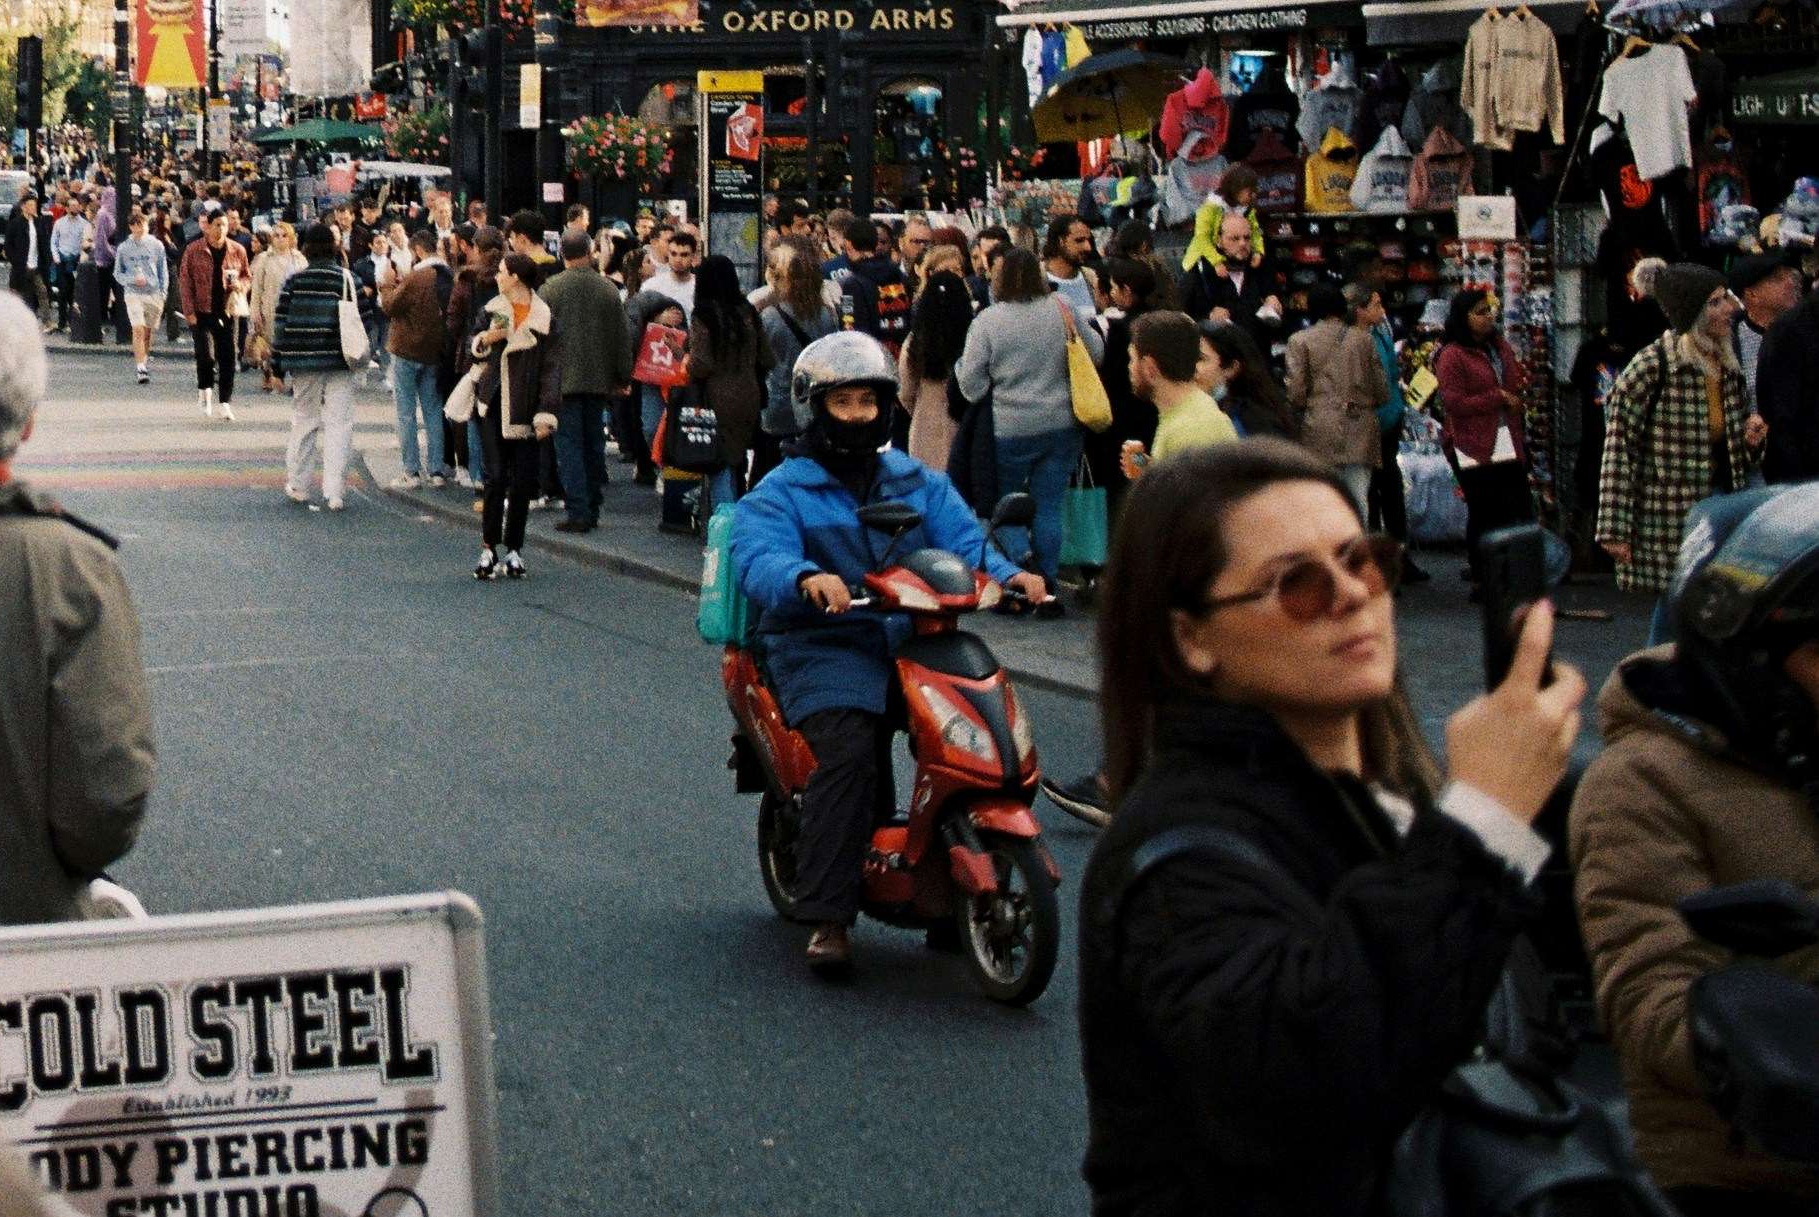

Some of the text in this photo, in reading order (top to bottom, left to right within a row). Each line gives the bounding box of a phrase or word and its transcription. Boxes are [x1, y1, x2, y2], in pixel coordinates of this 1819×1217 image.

[722, 9, 854, 33] OXFORD
[869, 8, 955, 32] ARMS
[1258, 10, 1308, 29] CLOTHING
[186, 964, 441, 1087] STEEL
[123, 1084, 295, 1114] Established 1993
[32, 1120, 429, 1193] ODY PIERCING
[105, 1183, 320, 1217] STUDIO
